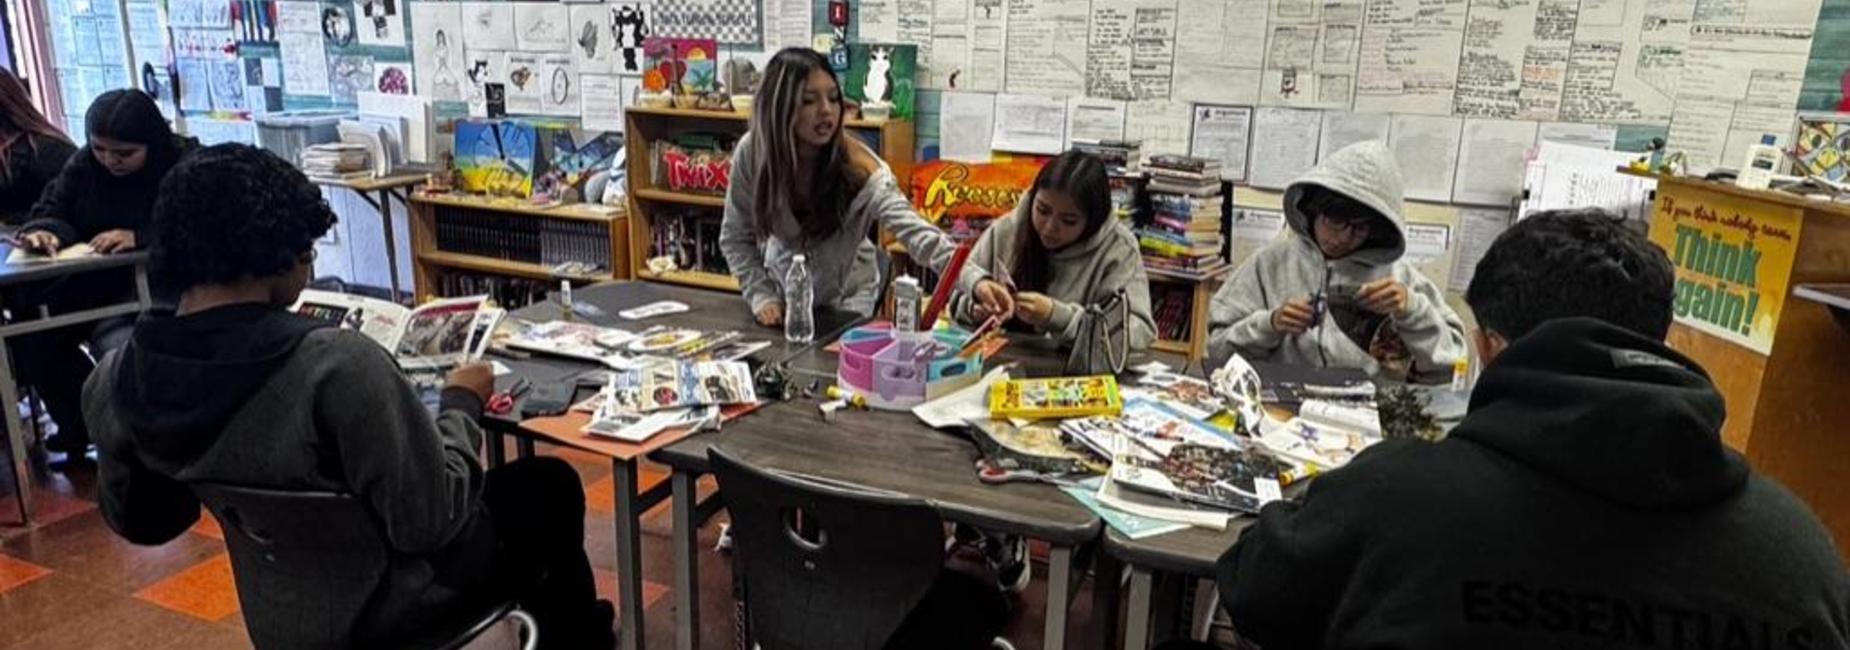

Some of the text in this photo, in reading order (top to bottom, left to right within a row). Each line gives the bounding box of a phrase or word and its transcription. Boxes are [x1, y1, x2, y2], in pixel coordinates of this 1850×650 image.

[1661, 196, 1674, 215] If
[1672, 207, 1692, 222] you
[1694, 205, 1718, 223] think
[1720, 214, 1759, 241] nobody
[1675, 223, 1762, 288] Think
[1673, 277, 1761, 337] gain!
[1461, 580, 1815, 650] ESSENTIALS
